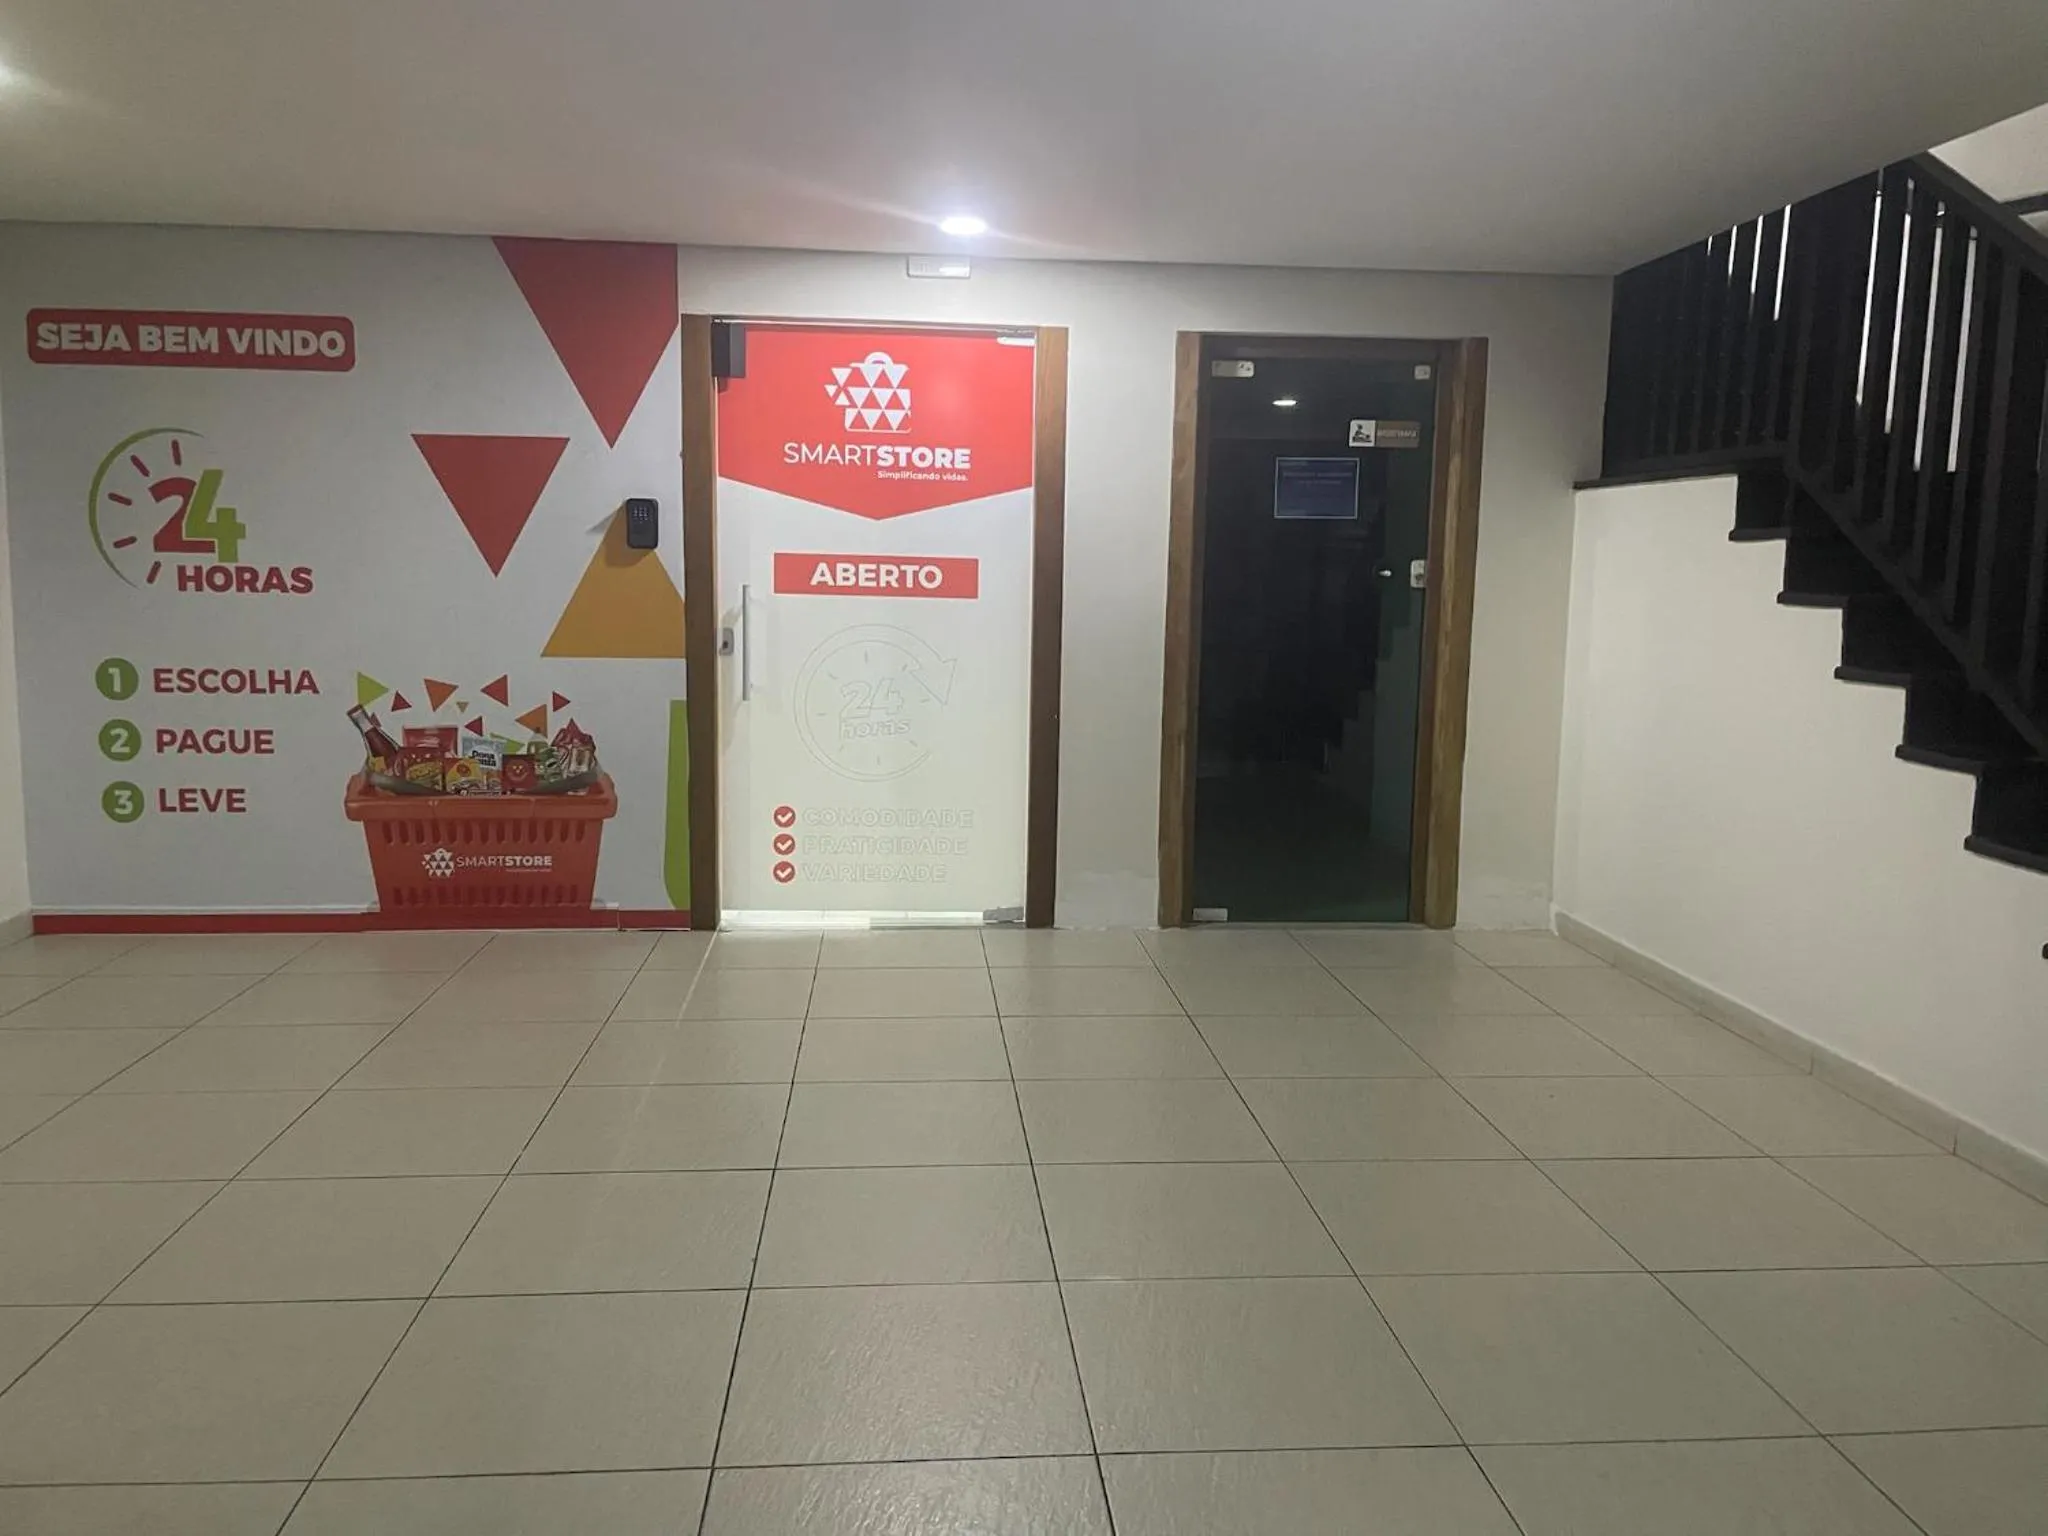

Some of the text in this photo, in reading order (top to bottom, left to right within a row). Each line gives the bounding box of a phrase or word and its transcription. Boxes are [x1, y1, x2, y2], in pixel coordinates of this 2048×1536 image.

[36, 323, 346, 358] SEJA BEM VINDO
[783, 442, 971, 469] SMARTSTORE
[877, 471, 940, 481] Simplificando
[148, 469, 246, 563] 24
[177, 565, 314, 594] HORAS
[810, 562, 943, 589] ABERTO
[108, 667, 320, 694] 1 ESCOLHA
[840, 677, 904, 719] 24
[110, 728, 275, 754] 2 PAGUE
[840, 719, 911, 739] horas
[114, 788, 247, 815] 3 LEVE
[802, 808, 974, 828] COMODIDADE
[802, 835, 968, 855] PRATICIDADE
[456, 855, 552, 867] SMARTSTORE
[802, 862, 948, 883] VARIEDADE
